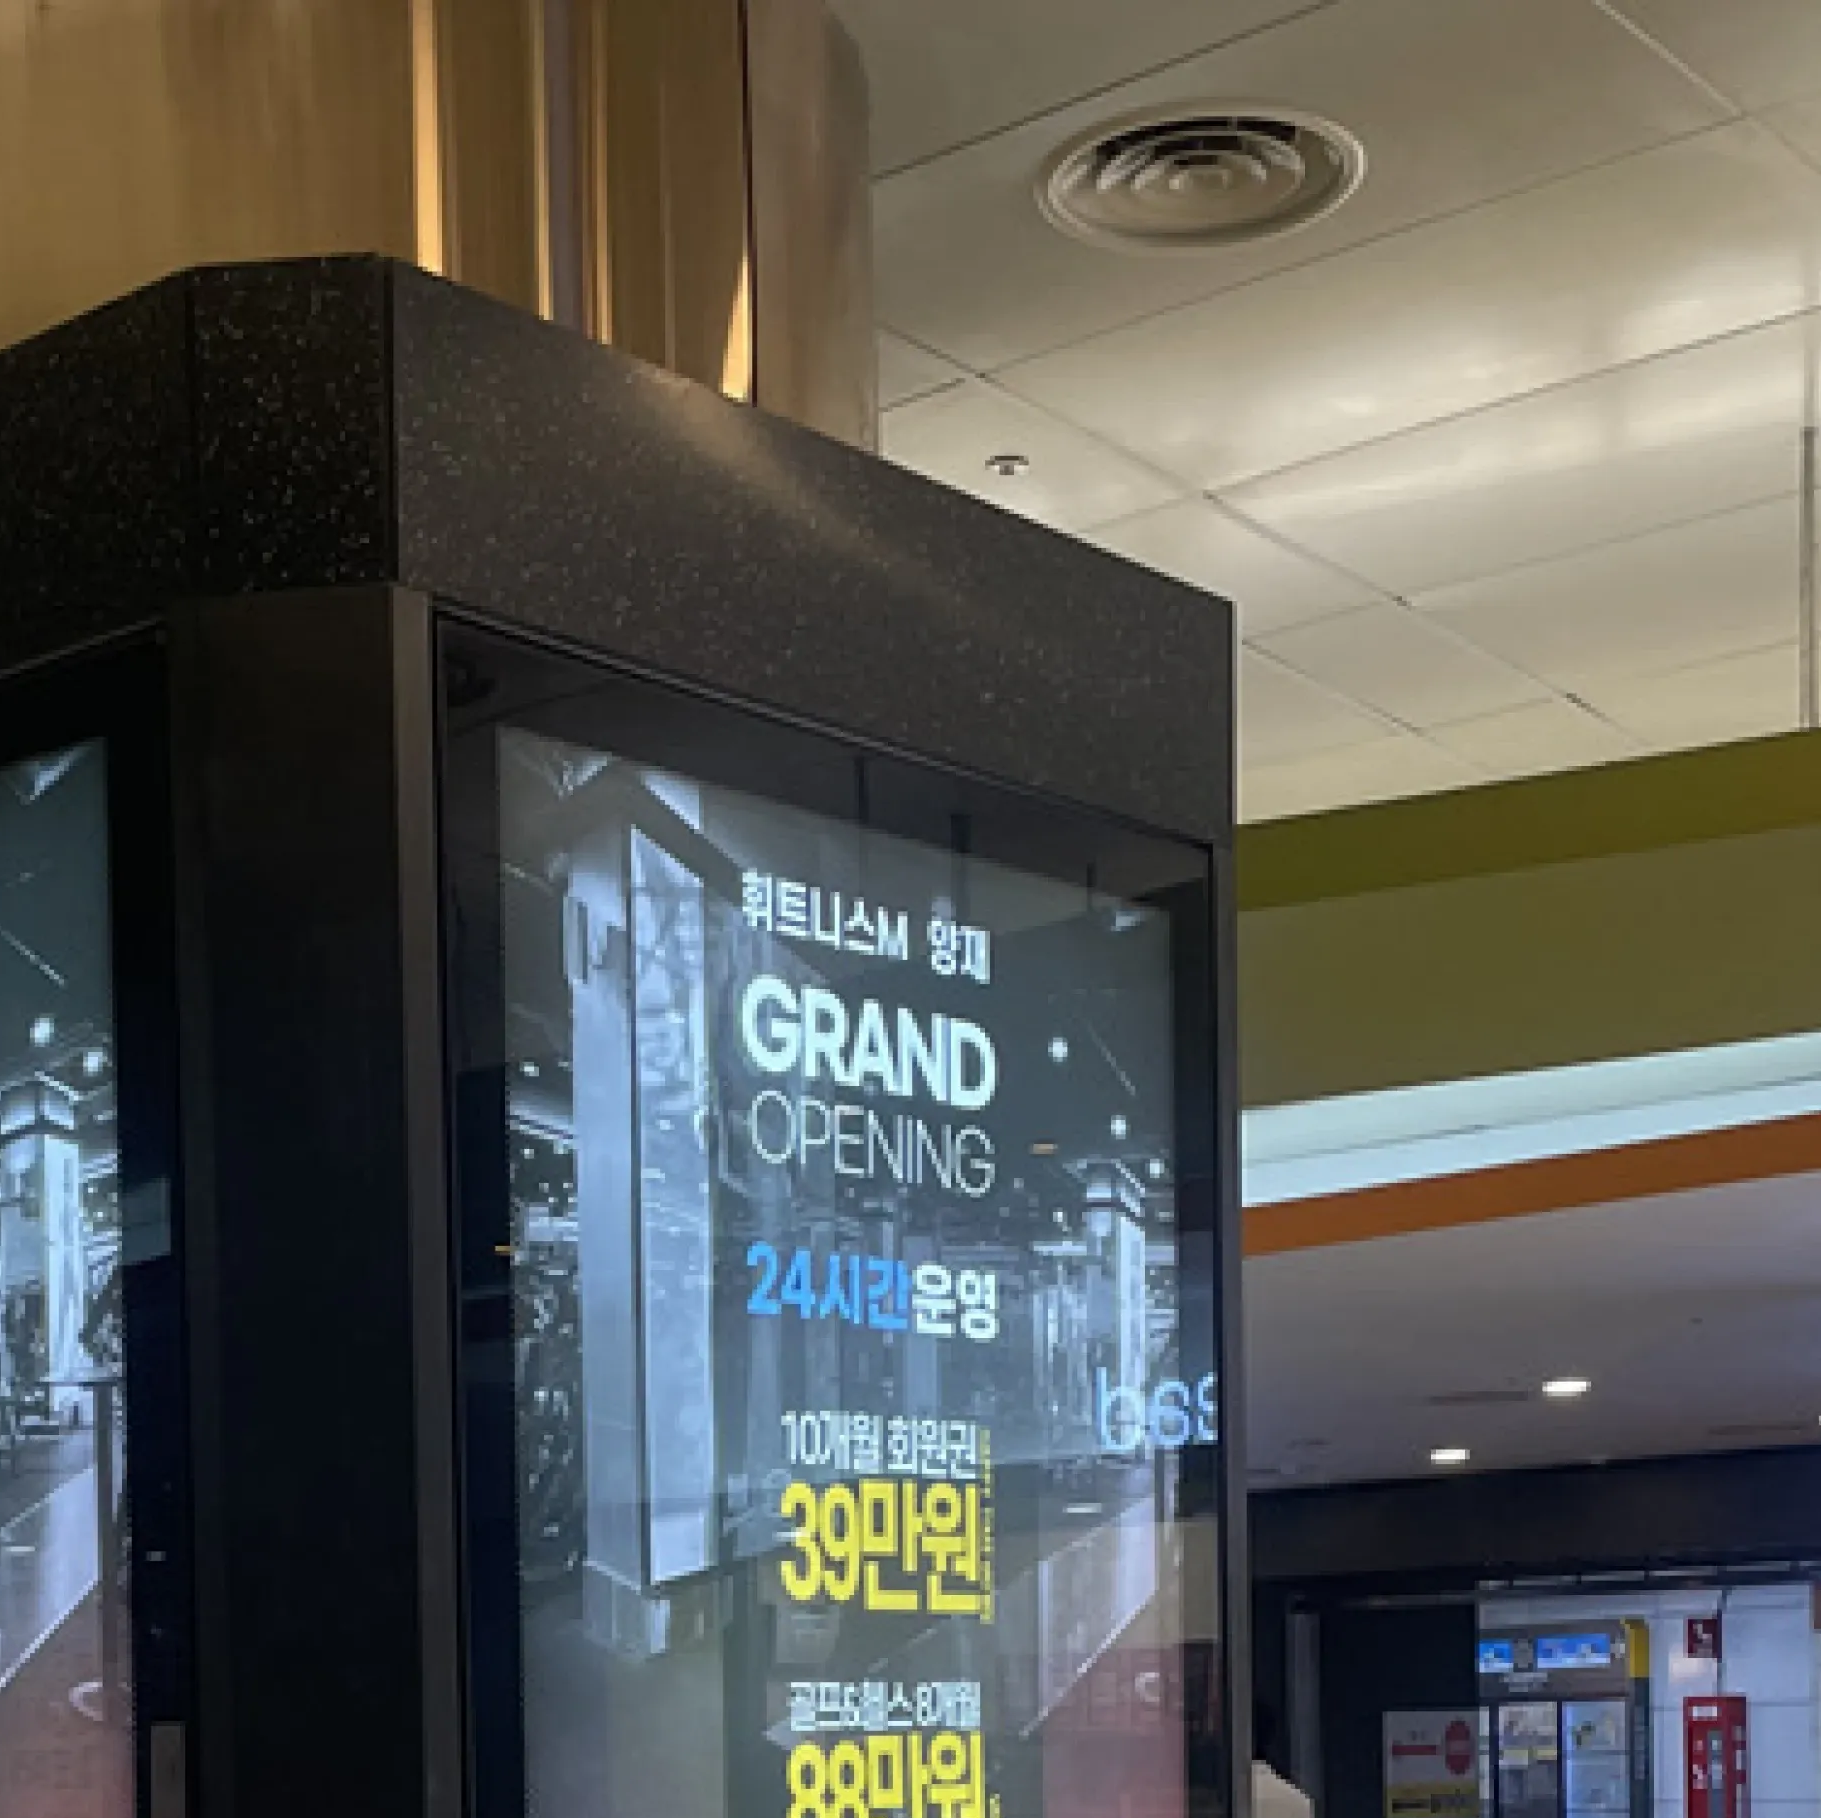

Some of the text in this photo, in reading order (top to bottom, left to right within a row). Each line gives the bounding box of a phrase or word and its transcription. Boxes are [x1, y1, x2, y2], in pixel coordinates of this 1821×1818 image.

[742, 867, 991, 984] 휘트니스M 양재
[741, 973, 996, 1111] GRAND
[750, 1089, 996, 1198] OPENING
[780, 1409, 978, 1480] 10개월 회원권
[780, 1477, 980, 1612] 39만원
